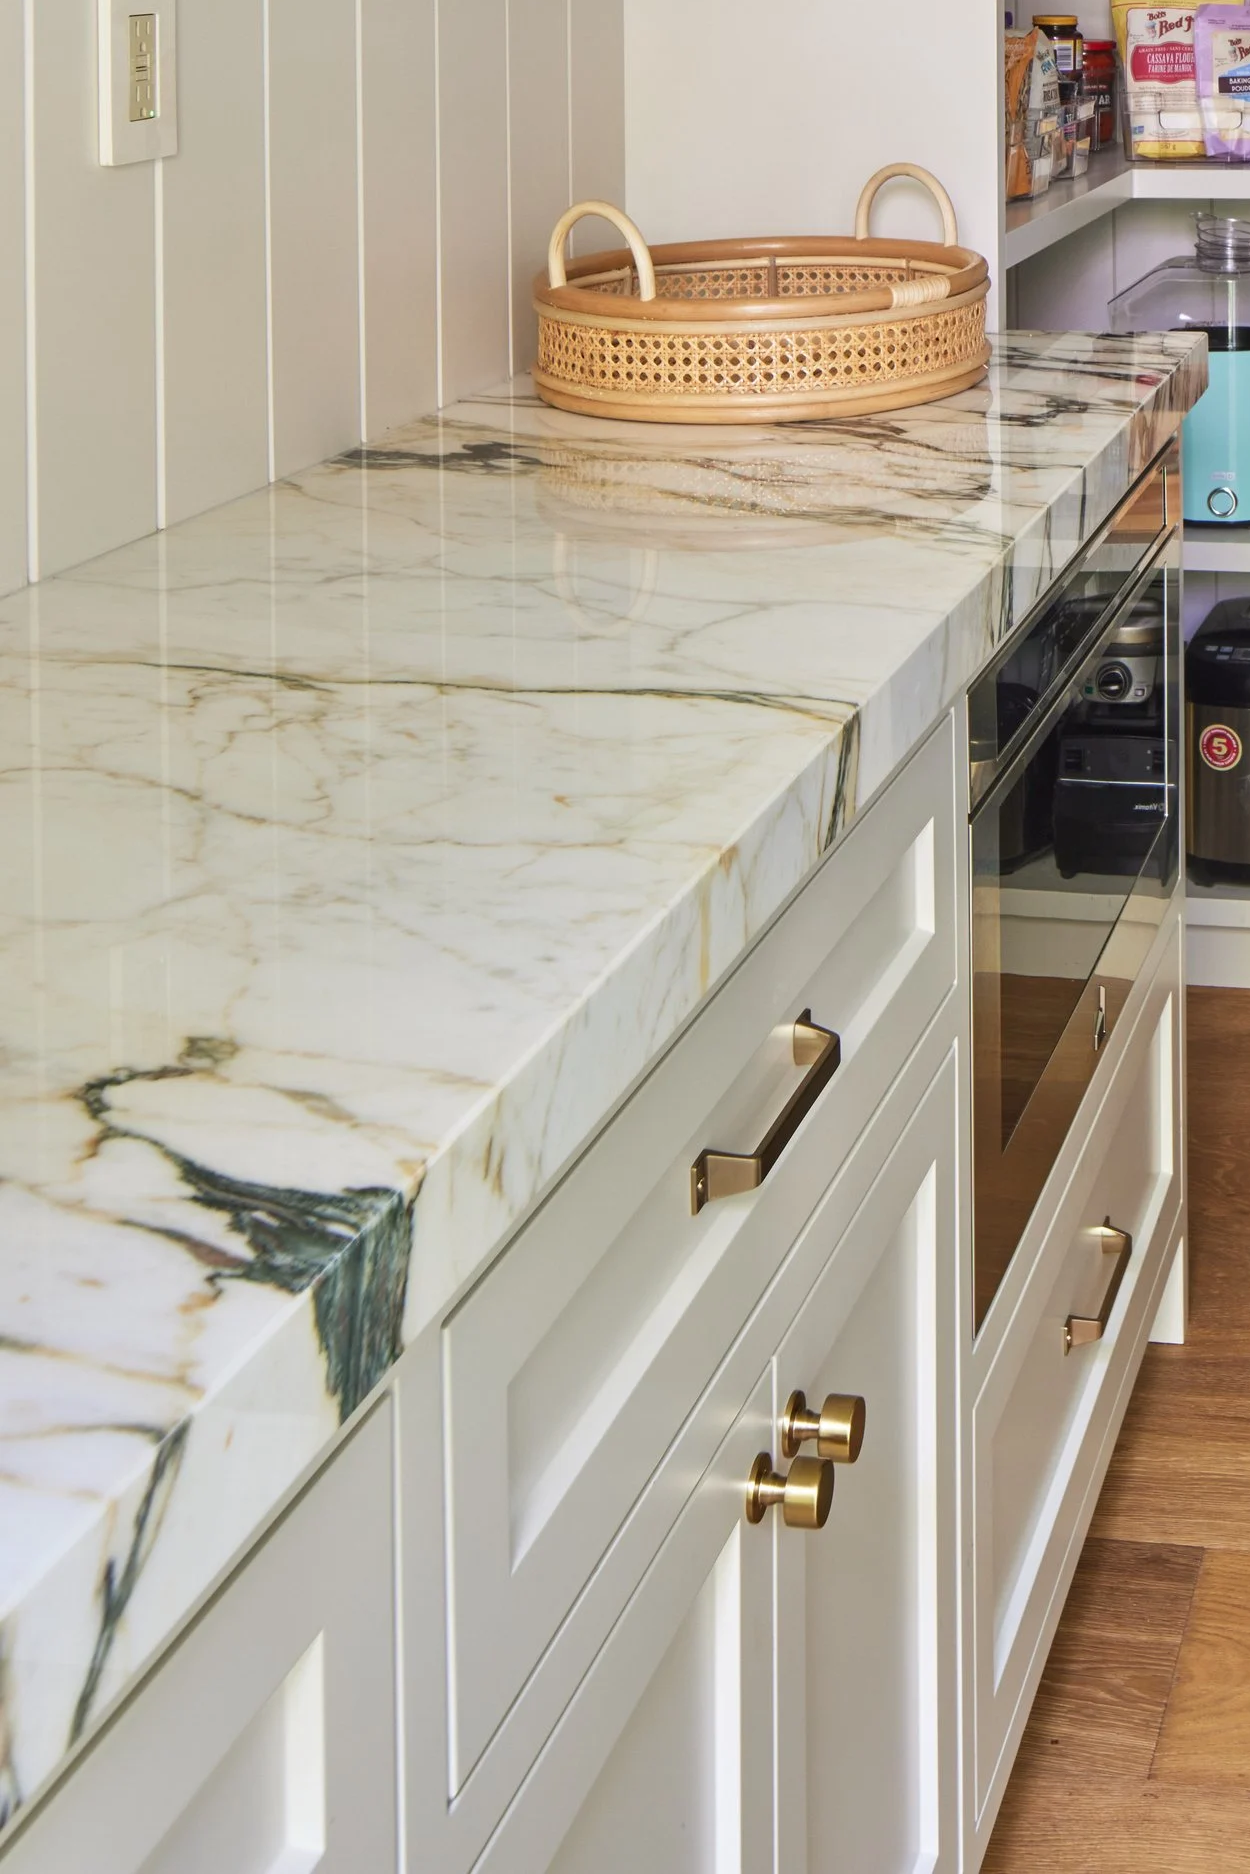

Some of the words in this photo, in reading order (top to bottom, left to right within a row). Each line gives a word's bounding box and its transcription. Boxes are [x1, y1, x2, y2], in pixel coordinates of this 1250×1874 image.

[1147, 11, 1167, 22] Bob's
[1158, 17, 1183, 38] Red
[1147, 52, 1174, 64] CASSAVA
[1147, 64, 1167, 73] FARINE
[1212, 737, 1228, 756] 5
